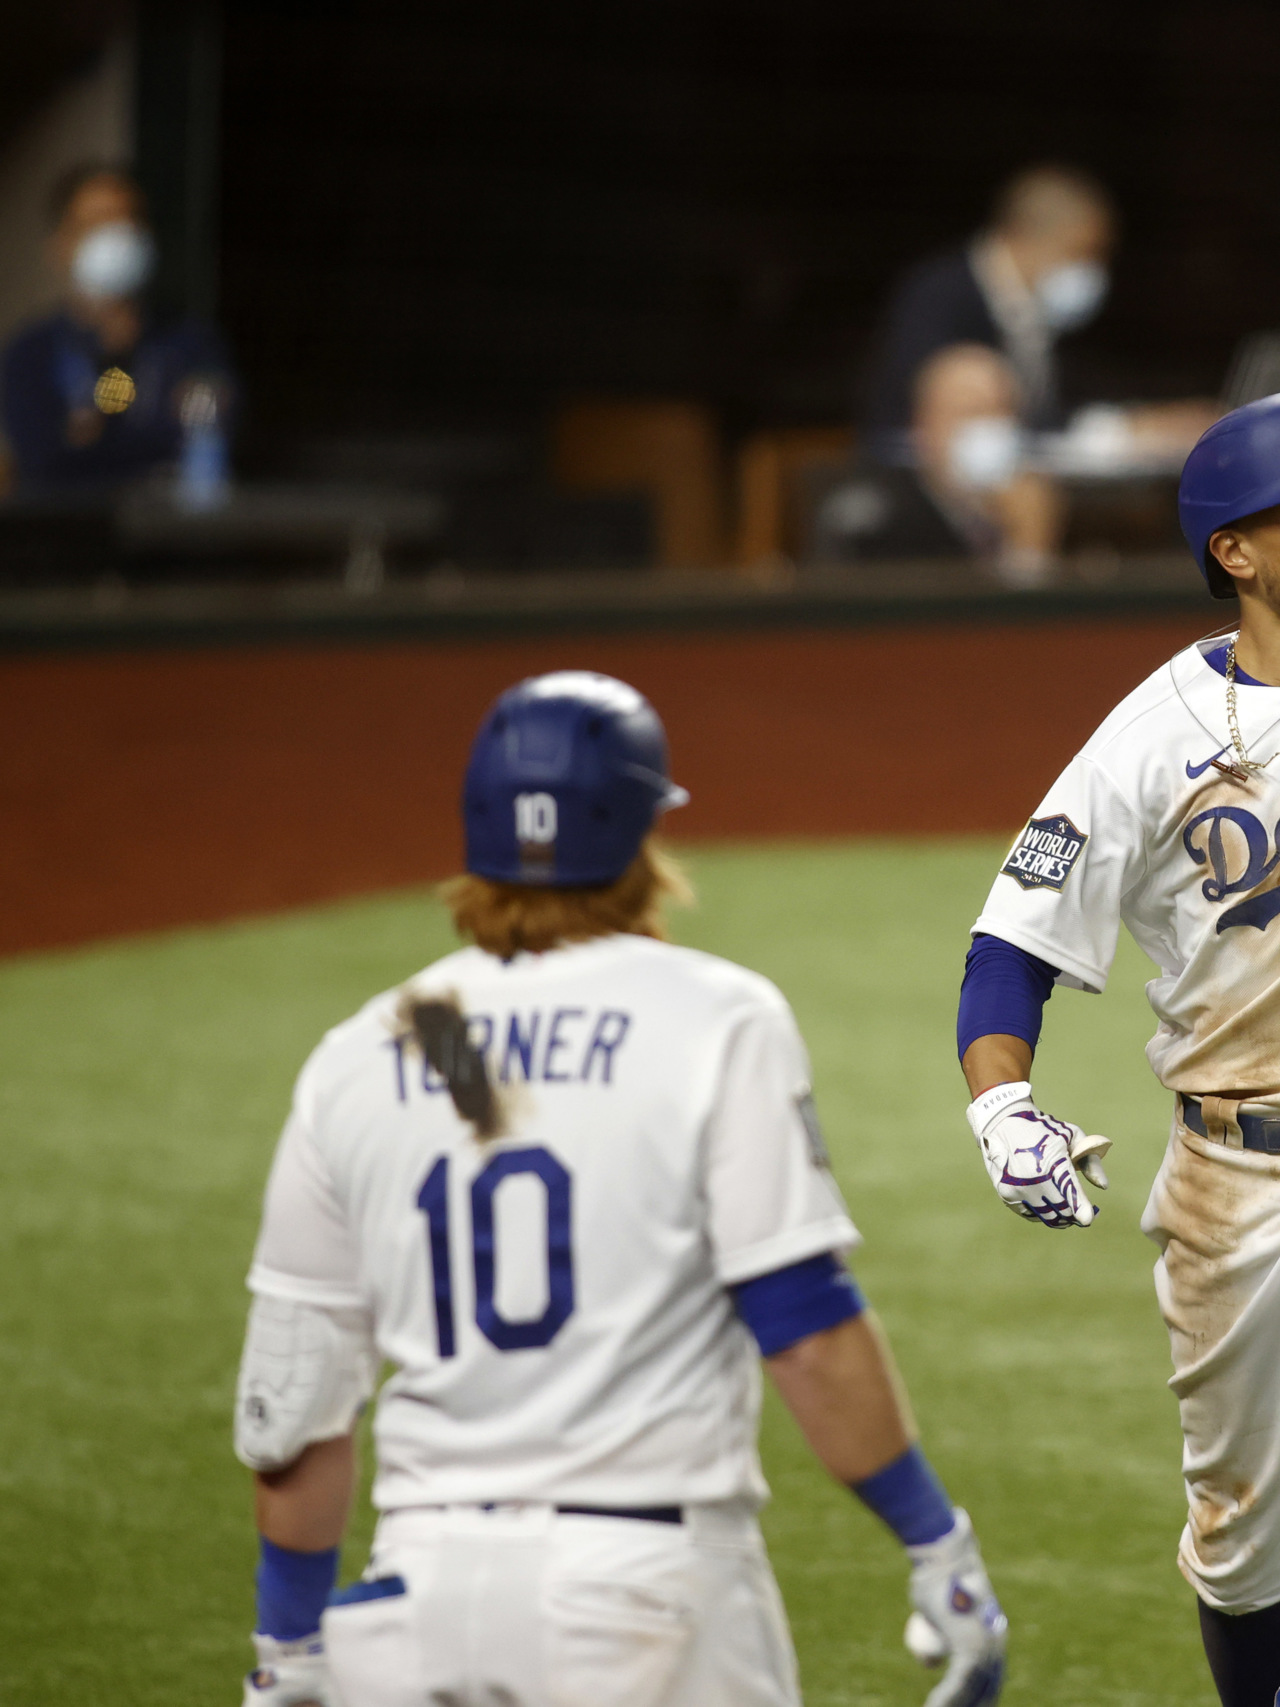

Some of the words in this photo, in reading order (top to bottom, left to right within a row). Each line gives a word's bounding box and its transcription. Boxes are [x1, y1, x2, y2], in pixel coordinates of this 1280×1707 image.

[515, 791, 558, 843] 10
[1008, 847, 1071, 881] SERIES
[1023, 827, 1080, 861] WORLD
[414, 1144, 577, 1360] 10
